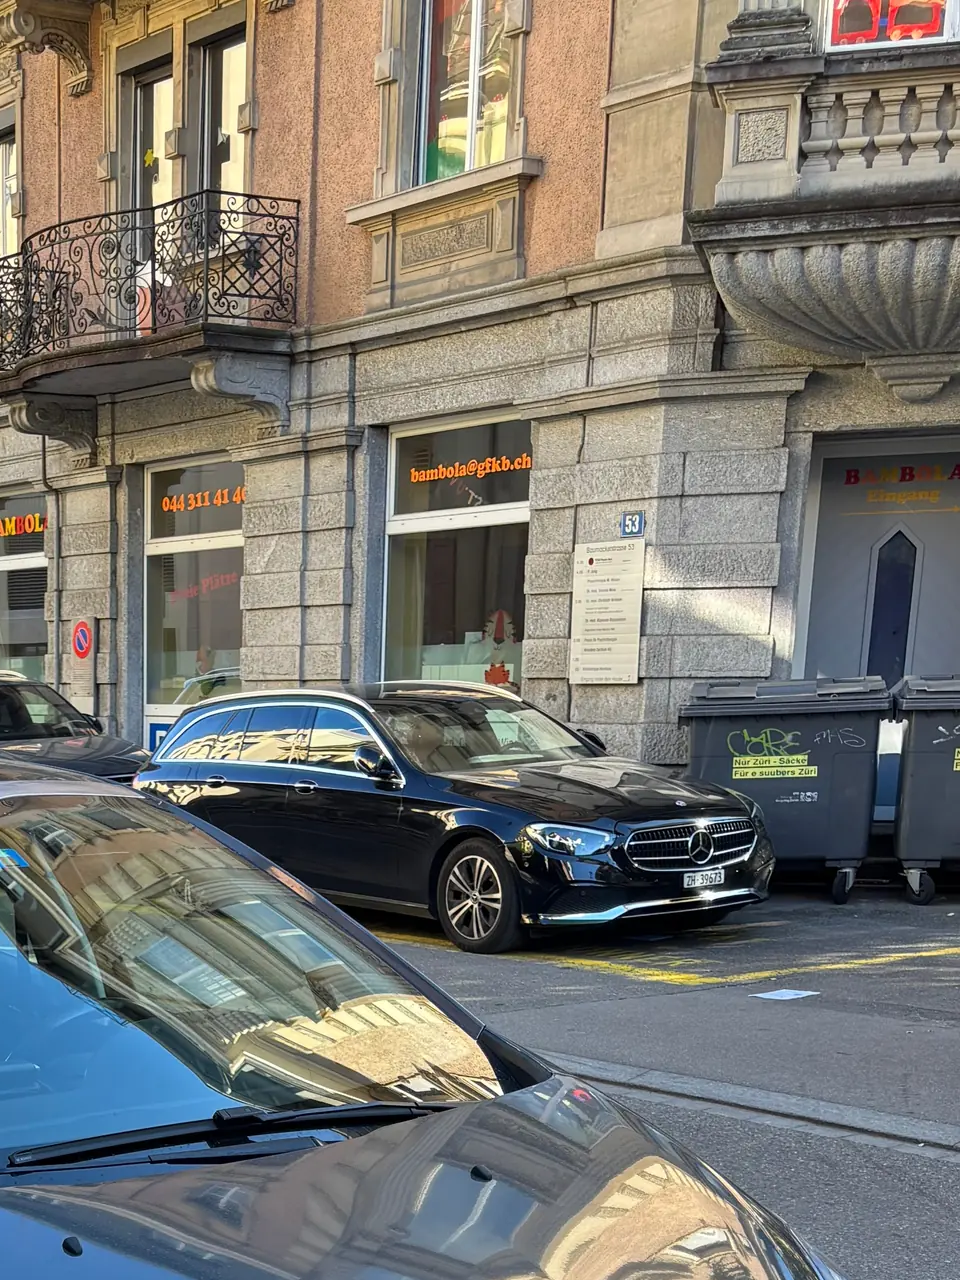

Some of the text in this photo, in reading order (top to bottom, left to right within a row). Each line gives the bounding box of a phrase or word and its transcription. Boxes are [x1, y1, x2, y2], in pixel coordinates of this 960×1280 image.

[410, 452, 531, 484] bambola@gfkb.ch
[844, 464, 960, 486] BAMBOLA
[162, 493, 185, 512] 044
[187, 490, 210, 511] 311
[213, 488, 229, 506] 41
[866, 489, 940, 504] Eingang
[625, 514, 639, 532] 53
[734, 758, 750, 766] Nur
[753, 757, 771, 766] Züri
[778, 756, 807, 765] Säcke
[734, 769, 749, 777] Für
[759, 768, 796, 777] suubers
[798, 767, 817, 776] Züri
